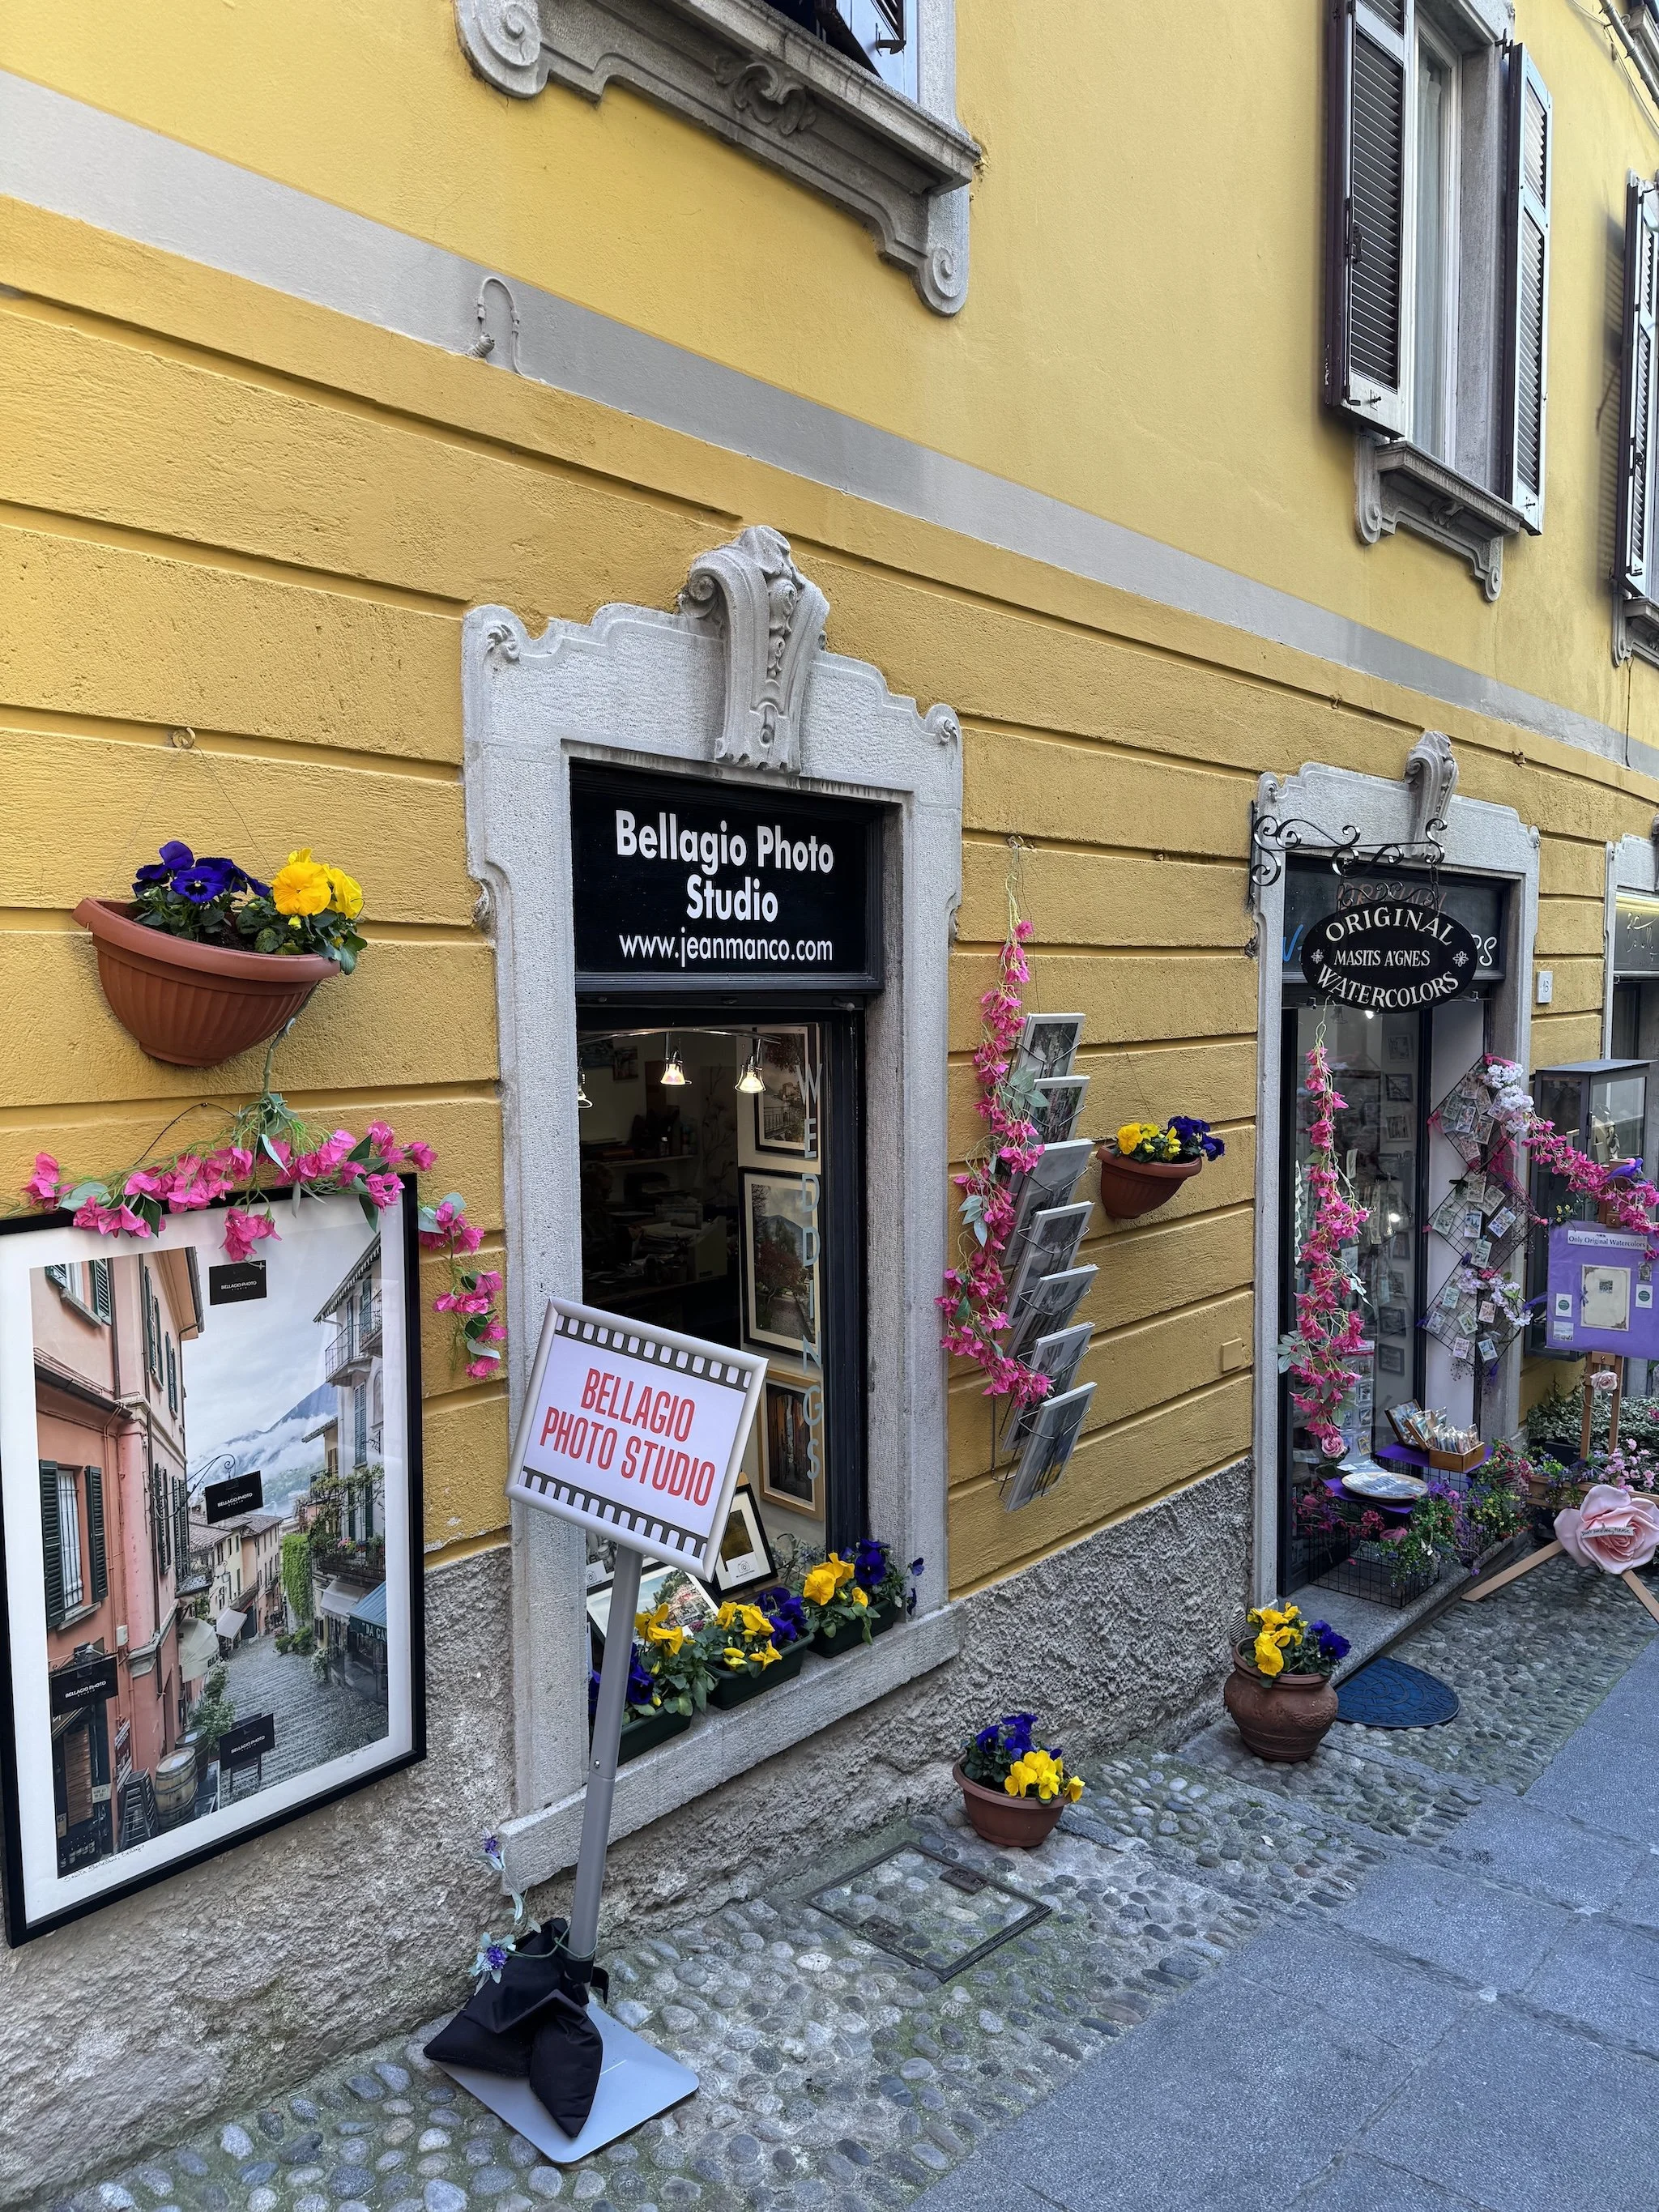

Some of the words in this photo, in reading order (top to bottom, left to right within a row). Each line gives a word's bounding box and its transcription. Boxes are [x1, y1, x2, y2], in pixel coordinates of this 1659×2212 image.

[616, 810, 747, 876] Bellagio
[757, 825, 834, 874] Photo
[686, 874, 778, 923] Studio
[619, 927, 833, 967] www.jeanmanco.com
[1325, 906, 1455, 946] ORIGINAL
[1333, 949, 1381, 966] MASITS
[1316, 964, 1459, 1008] WATERCOLORS
[1568, 1235, 1583, 1243] Only
[1584, 1237, 1608, 1246] Original
[1610, 1238, 1646, 1248] Watercolors
[795, 1063, 824, 1481] WEDDINGS
[580, 1368, 695, 1443] BELLAGIO
[539, 1406, 618, 1470] PHOTO
[621, 1435, 716, 1507] STUDIO
